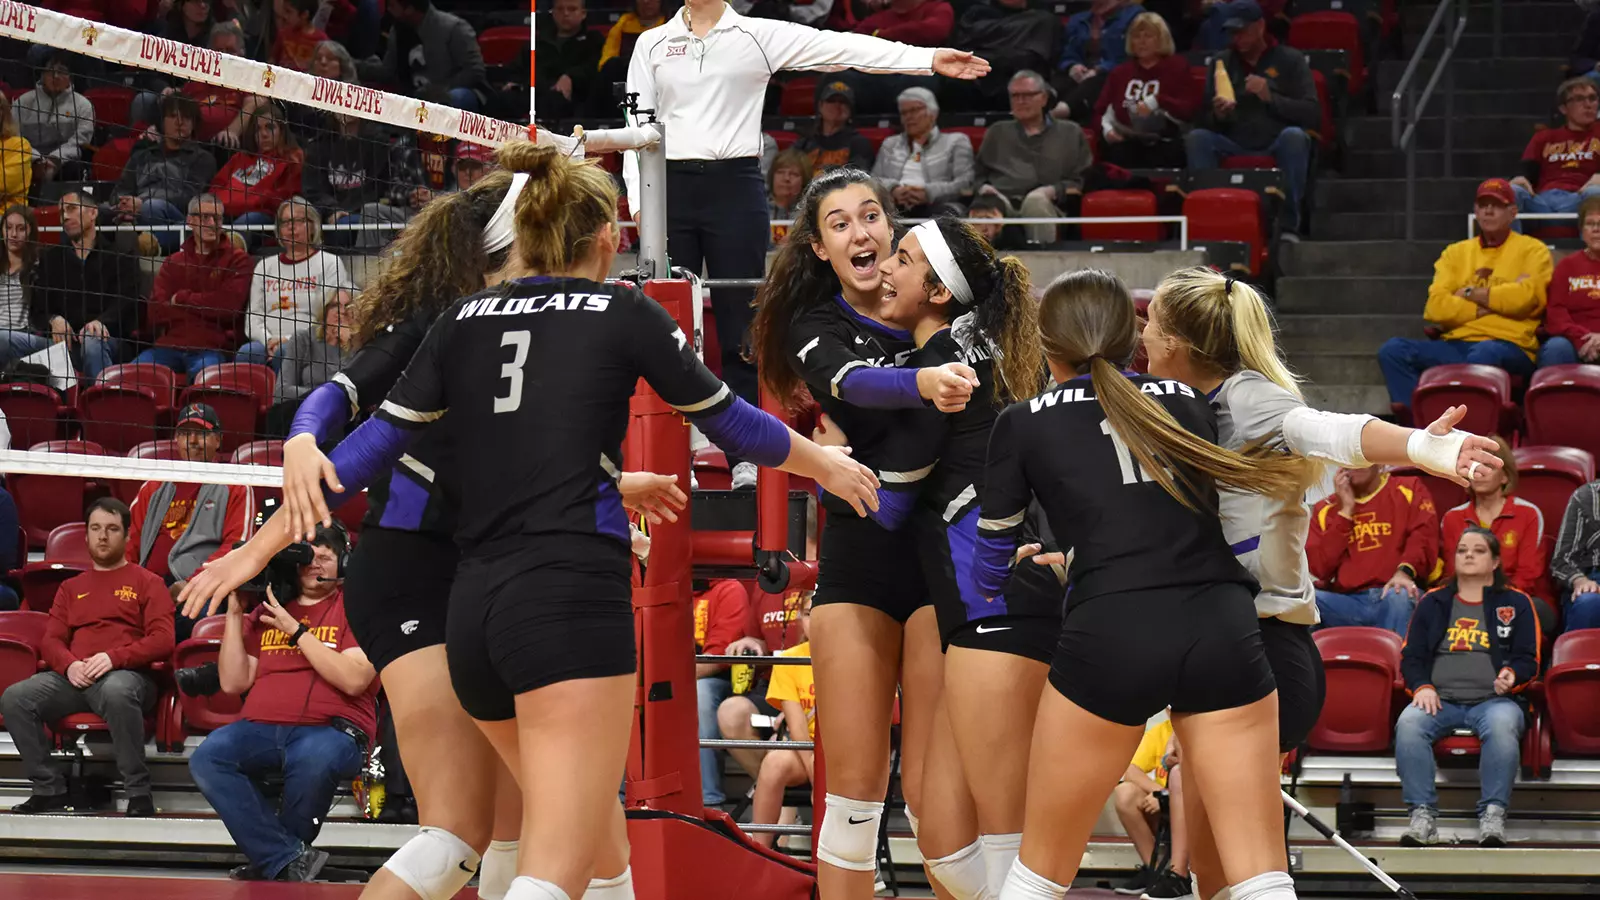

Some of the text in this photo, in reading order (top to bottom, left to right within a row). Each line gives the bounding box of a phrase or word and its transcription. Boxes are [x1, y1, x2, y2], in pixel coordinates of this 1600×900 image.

[0, 0, 38, 33] TATE
[140, 35, 222, 77] IOWA STATE
[312, 77, 383, 115] IOWA STATE
[1124, 79, 1160, 101] GO
[459, 110, 487, 138] IOWA
[1548, 151, 1593, 162] STATE
[456, 293, 612, 320] WILDCATS
[494, 330, 531, 413] 3
[1029, 380, 1196, 414] WILATS
[1447, 627, 1490, 648] TATE
